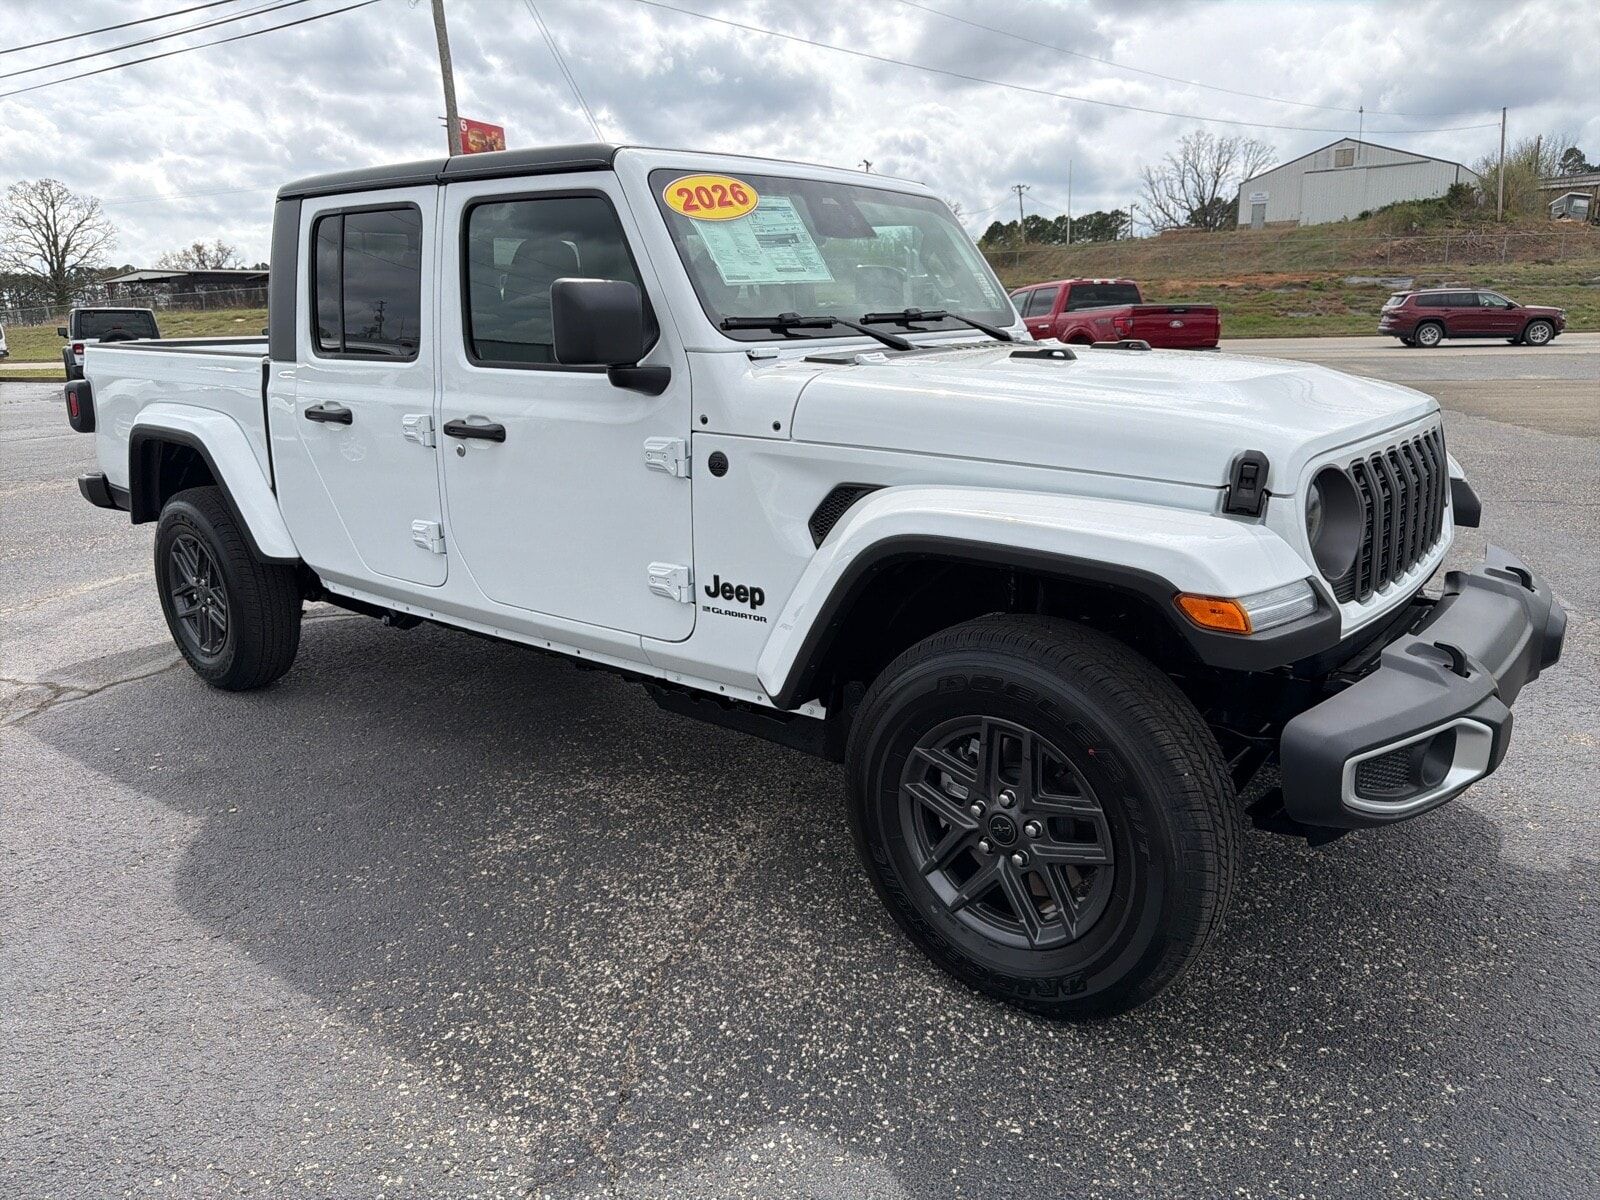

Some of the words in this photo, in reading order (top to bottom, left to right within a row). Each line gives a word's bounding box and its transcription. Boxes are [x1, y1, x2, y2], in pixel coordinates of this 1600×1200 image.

[676, 182, 750, 212] 2026
[704, 574, 765, 610] Jeep
[711, 606, 768, 624] GLADIATOR
